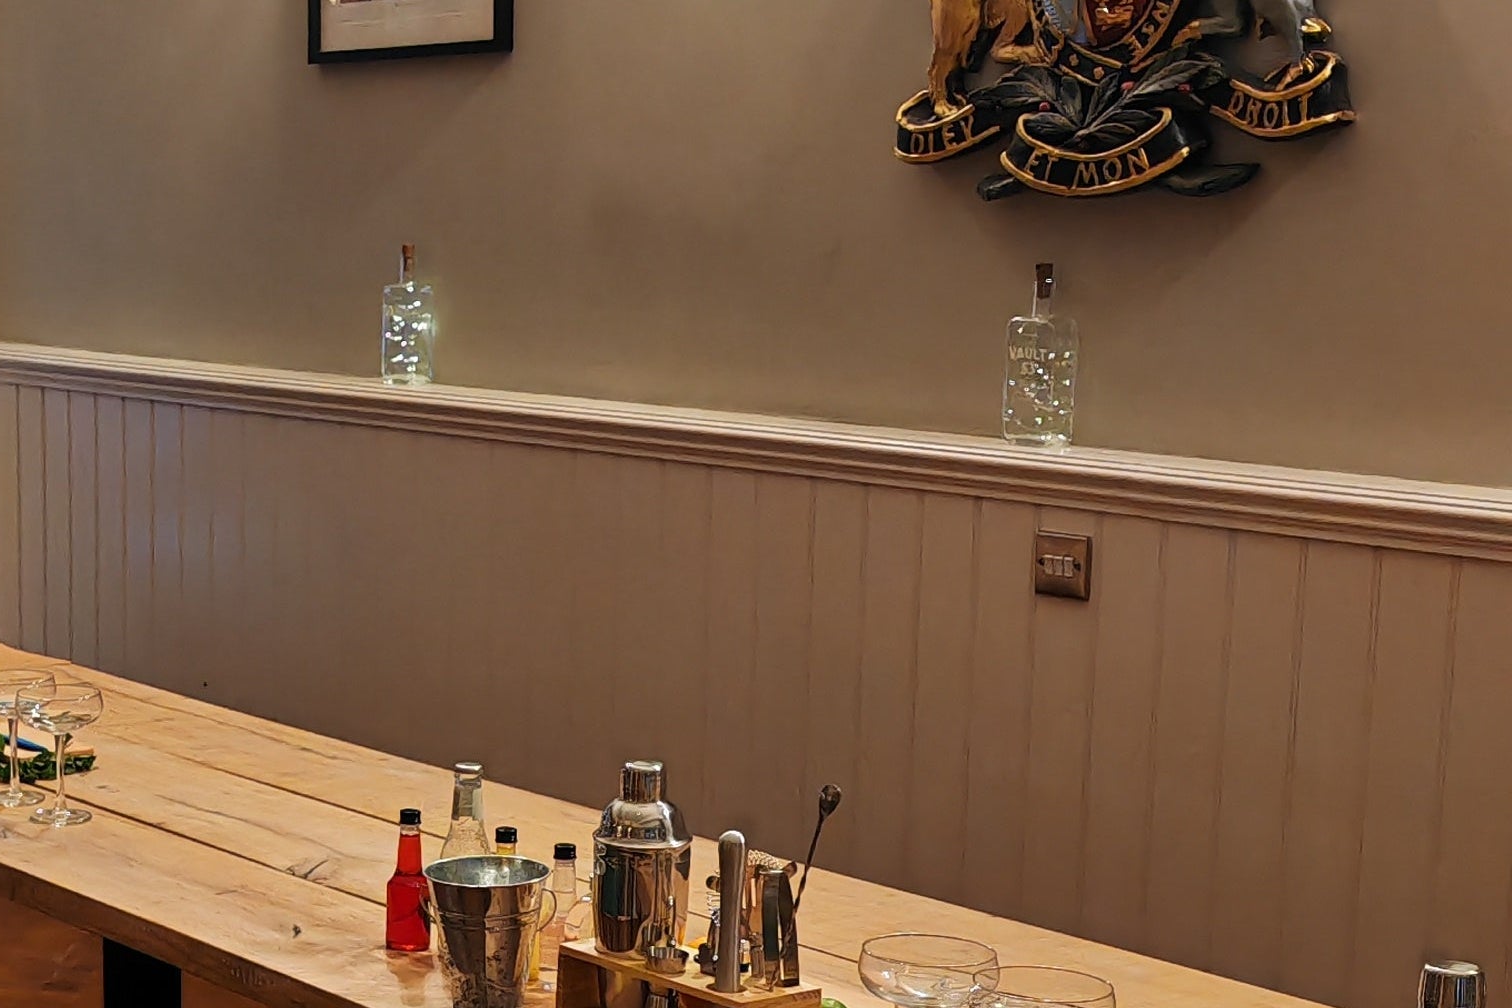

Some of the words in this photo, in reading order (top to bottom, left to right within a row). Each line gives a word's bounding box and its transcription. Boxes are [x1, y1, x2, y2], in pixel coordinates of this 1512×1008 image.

[1229, 91, 1313, 127] DROIT
[1024, 148, 1059, 181] ET
[1071, 147, 1150, 190] MON
[1008, 346, 1047, 361] VAULT
